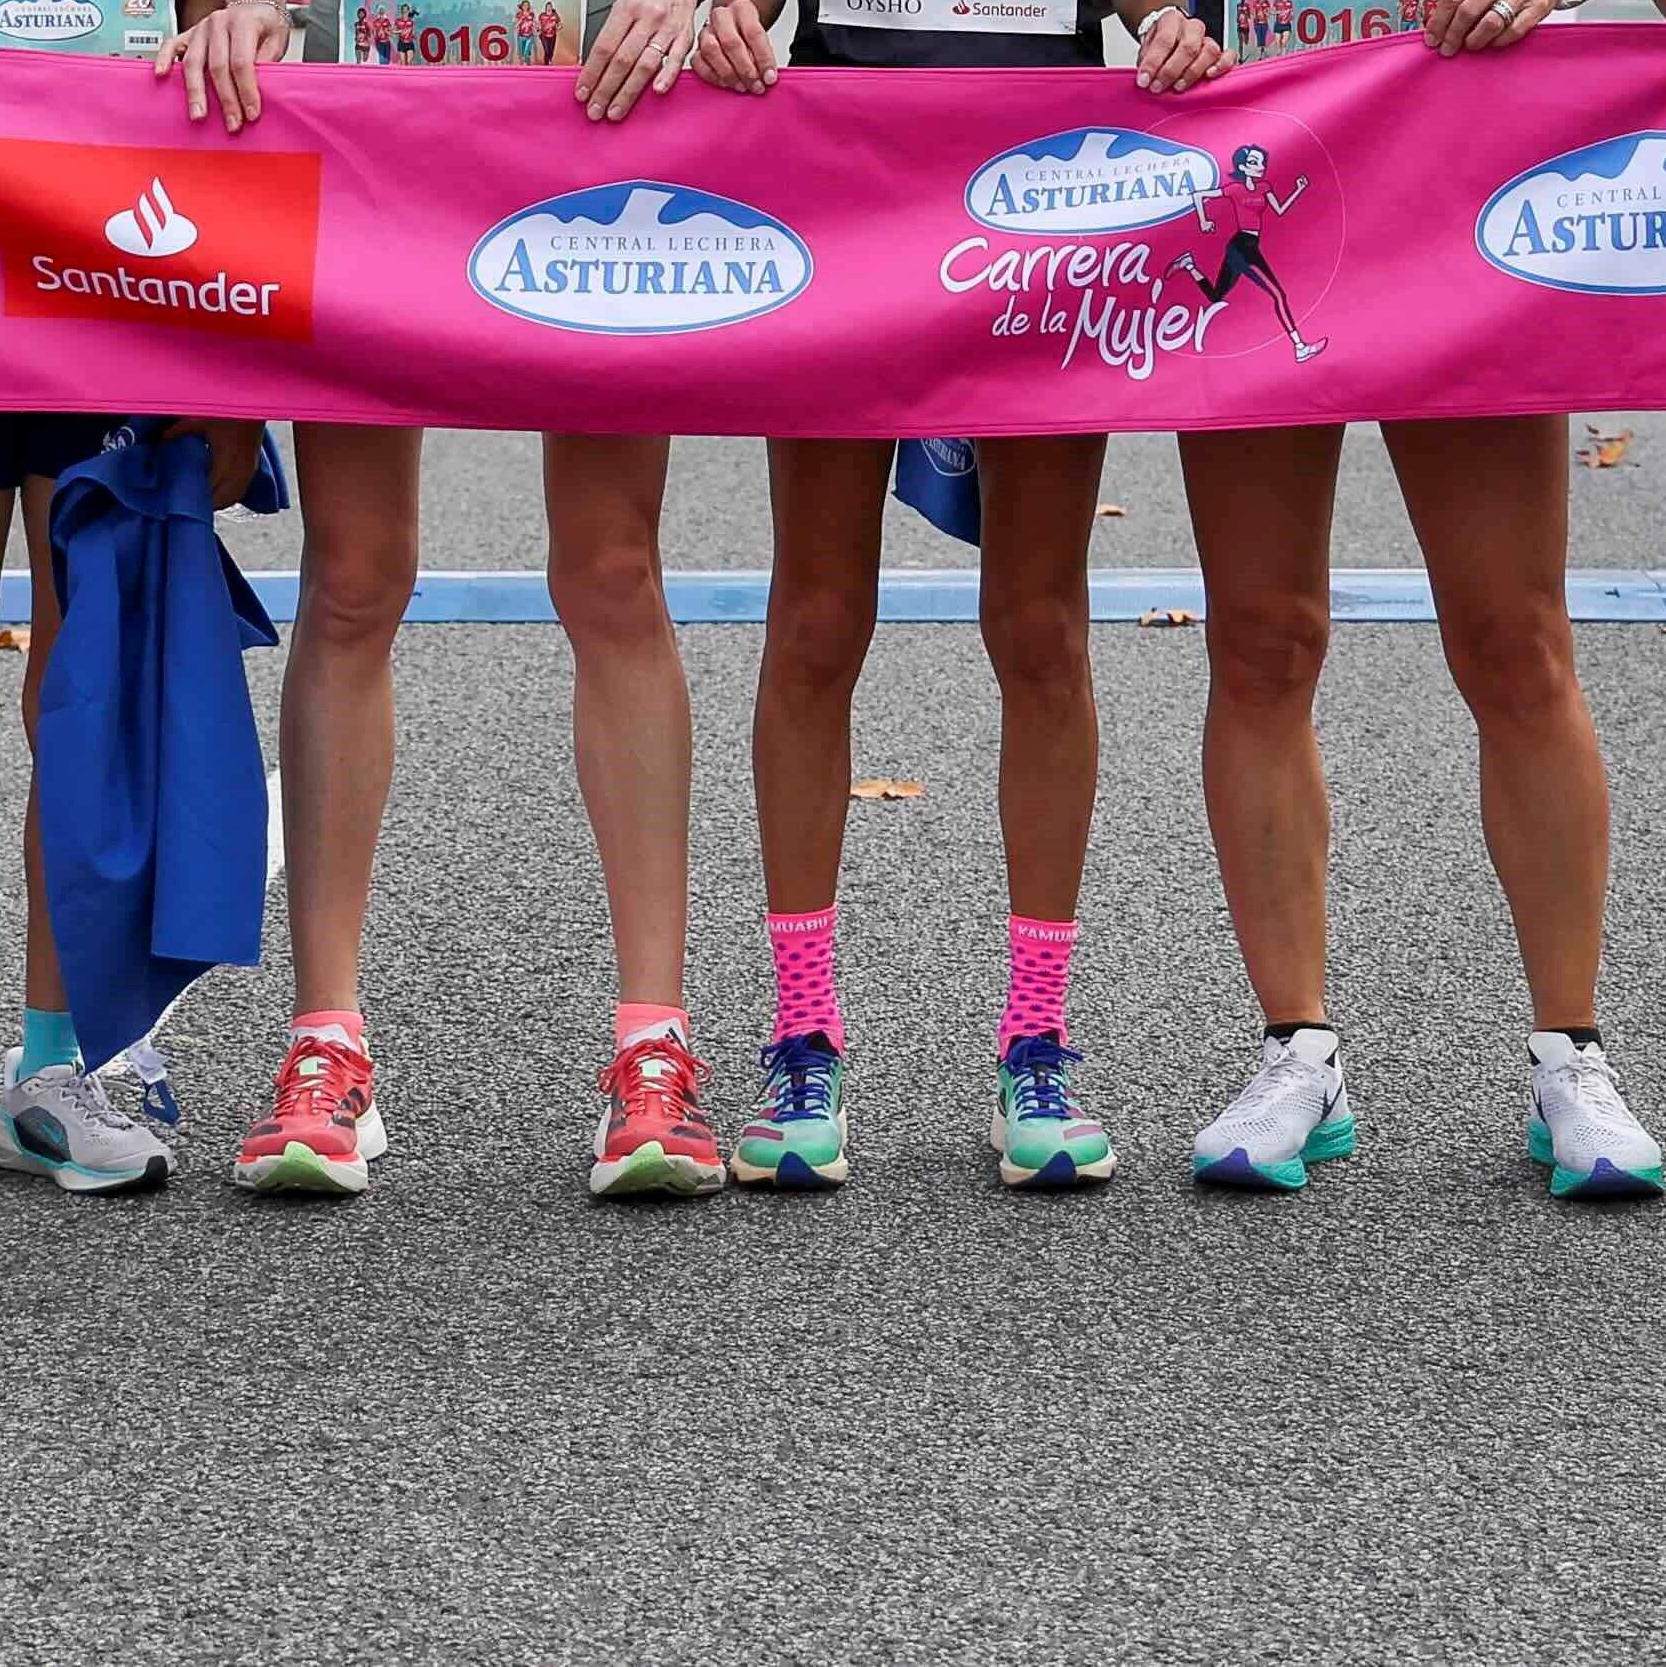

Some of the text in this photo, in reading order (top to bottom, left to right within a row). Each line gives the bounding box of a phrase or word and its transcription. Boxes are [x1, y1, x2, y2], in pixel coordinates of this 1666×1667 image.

[972, 2, 1047, 19] Santander
[1296, 7, 1392, 45] 016
[419, 24, 510, 64] 016
[1025, 155, 1192, 183] CENTRAL LECHERA
[988, 167, 1197, 219] ASTURIANA
[1555, 187, 1662, 209] CENTRAL
[551, 235, 776, 251] CENTRAL LECHERA
[31, 254, 281, 316] Santander
[495, 238, 785, 296] ASTURIANA
[938, 236, 1149, 295] Carrera
[992, 281, 1230, 380] de la Mujer
